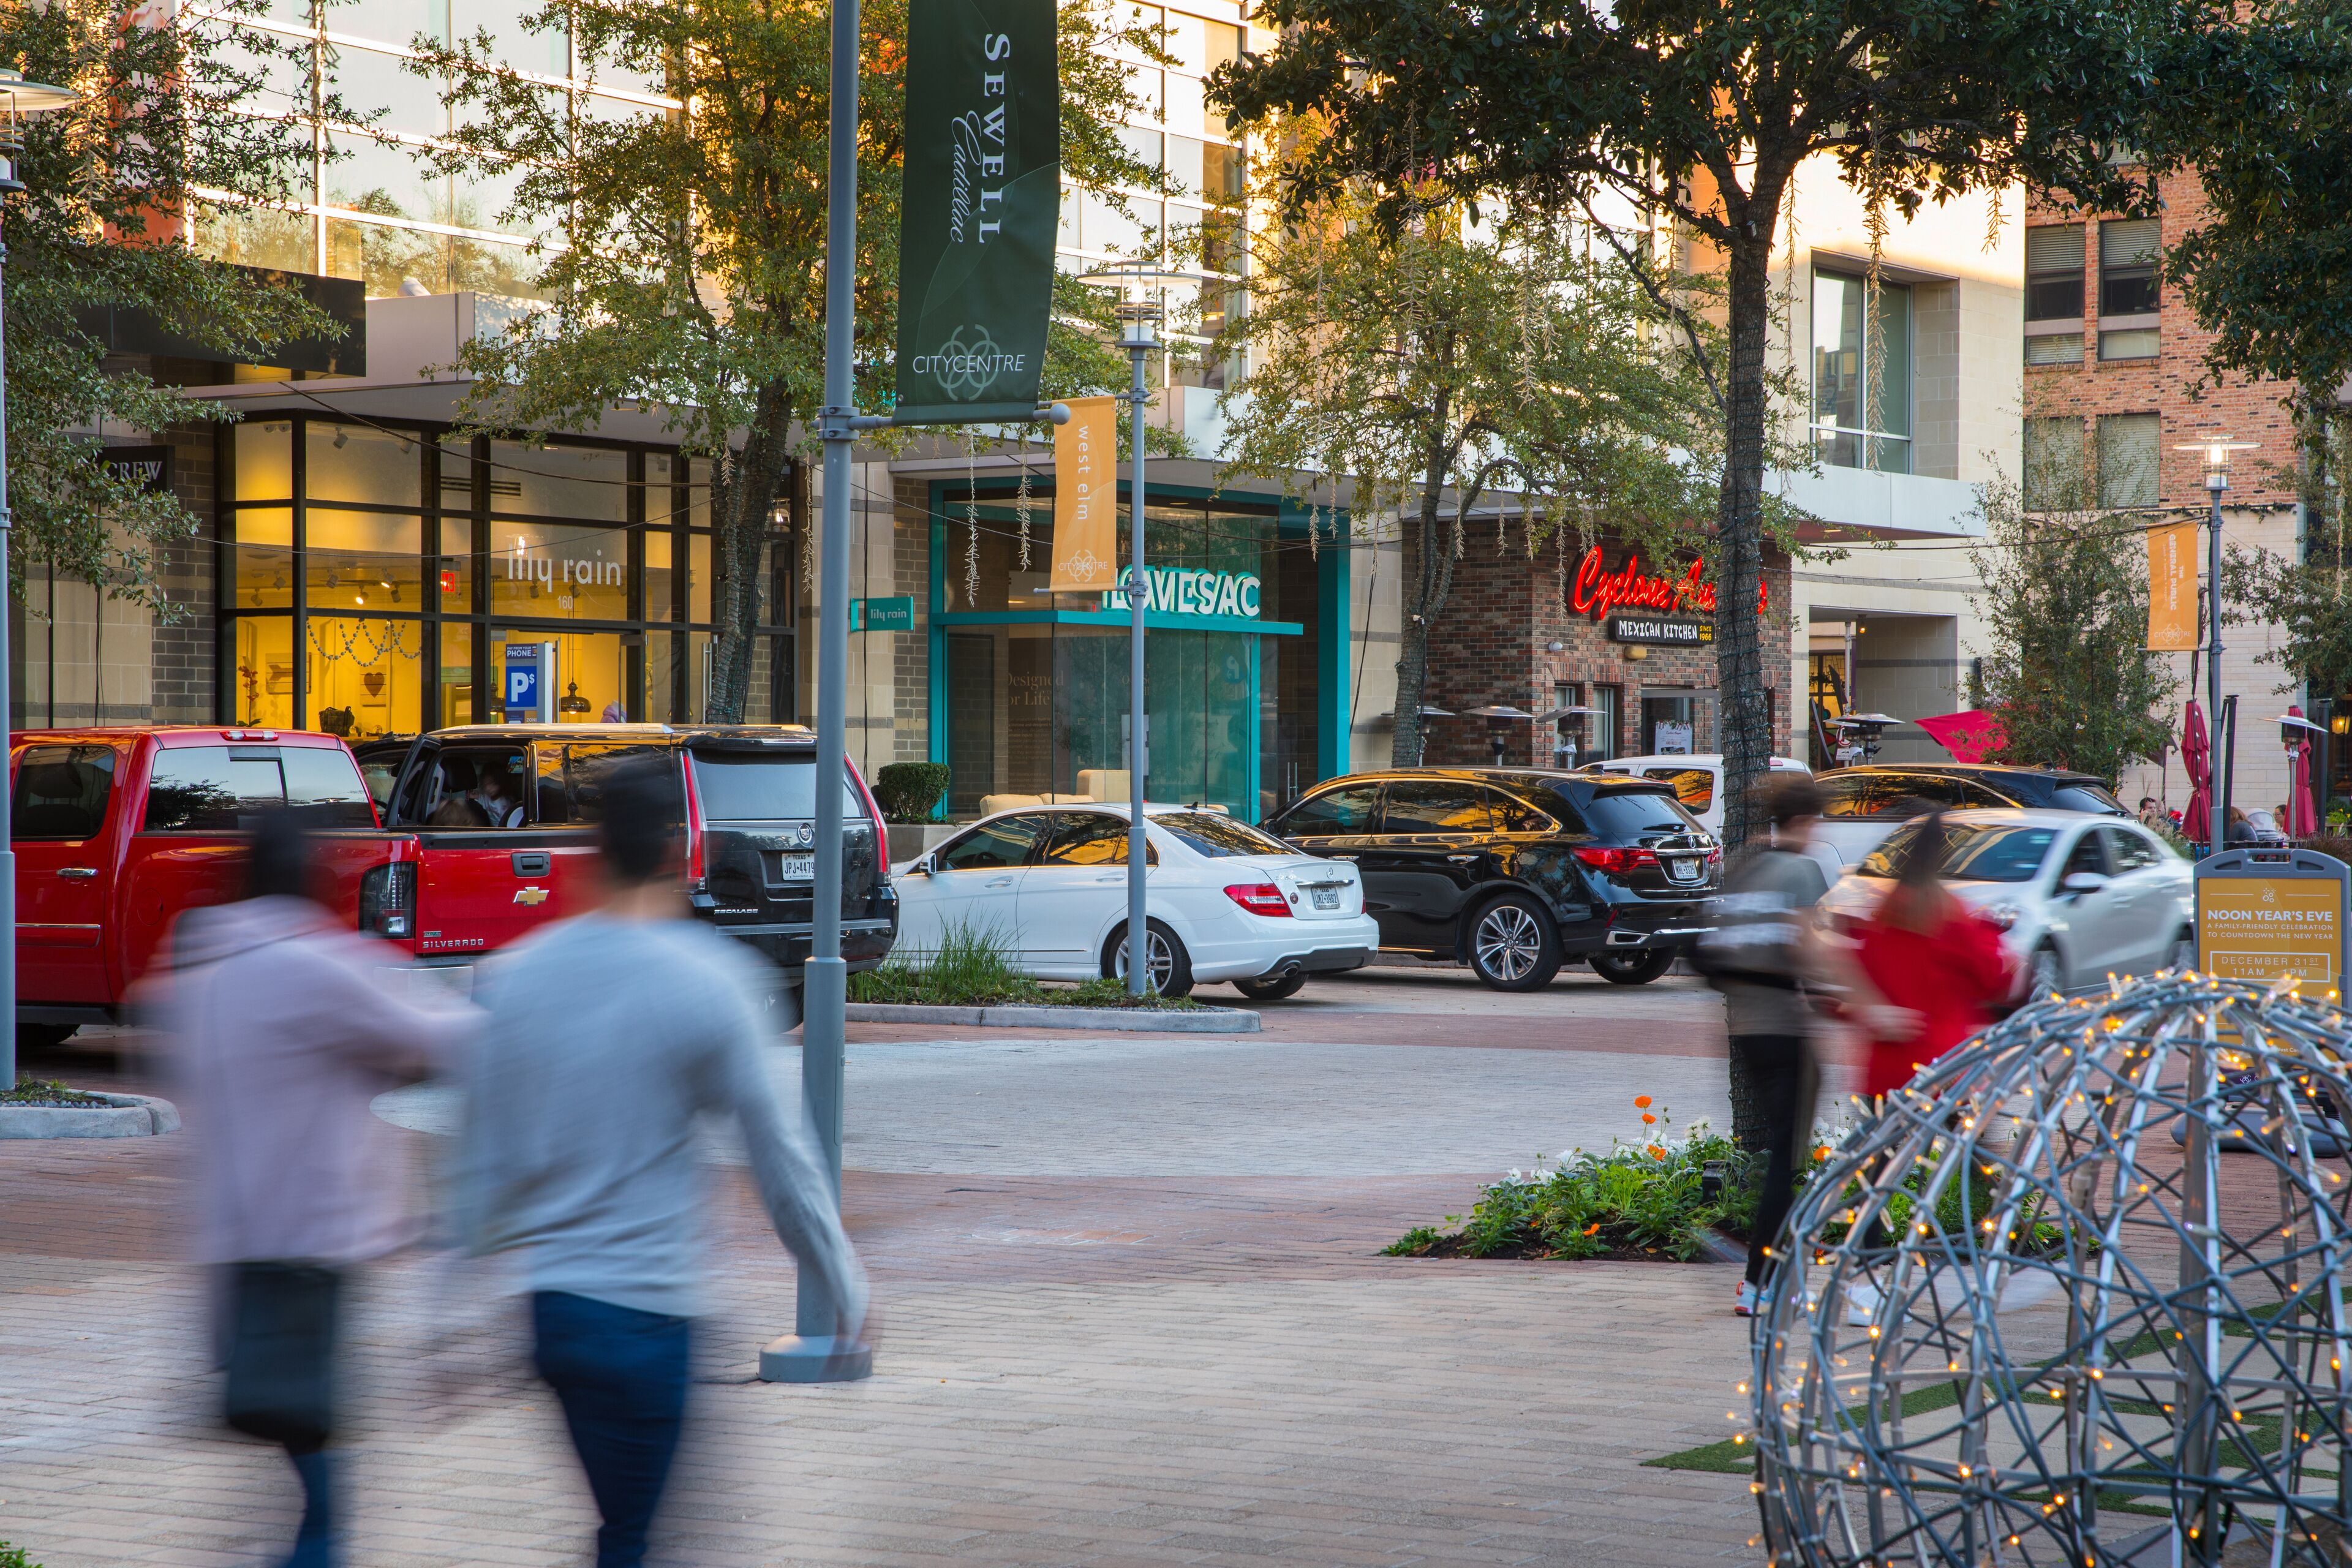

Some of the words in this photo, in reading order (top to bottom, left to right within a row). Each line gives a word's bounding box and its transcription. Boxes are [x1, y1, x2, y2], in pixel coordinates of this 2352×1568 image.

[979, 34, 1010, 243] SEWELL
[951, 110, 982, 243] Cadillac
[913, 354, 1026, 373] CITYCENTRE
[1078, 426, 1091, 474] west
[1078, 483, 1091, 519] elm
[508, 543, 552, 593] lily
[564, 549, 621, 586] rain
[1058, 561, 1108, 571] CITYCENTRE
[557, 595, 573, 609] 160
[870, 608, 885, 622] lily
[888, 608, 907, 619] rain
[1619, 620, 1660, 638] MEXICAN
[1664, 624, 1697, 639] KITCHEN
[2207, 910, 2252, 921] NOON
[2255, 910, 2303, 921] YEAR'S
[2306, 911, 2333, 922] EVE
[423, 939, 484, 948] SILVERADO
[2222, 956, 2288, 966] DECEMBER
